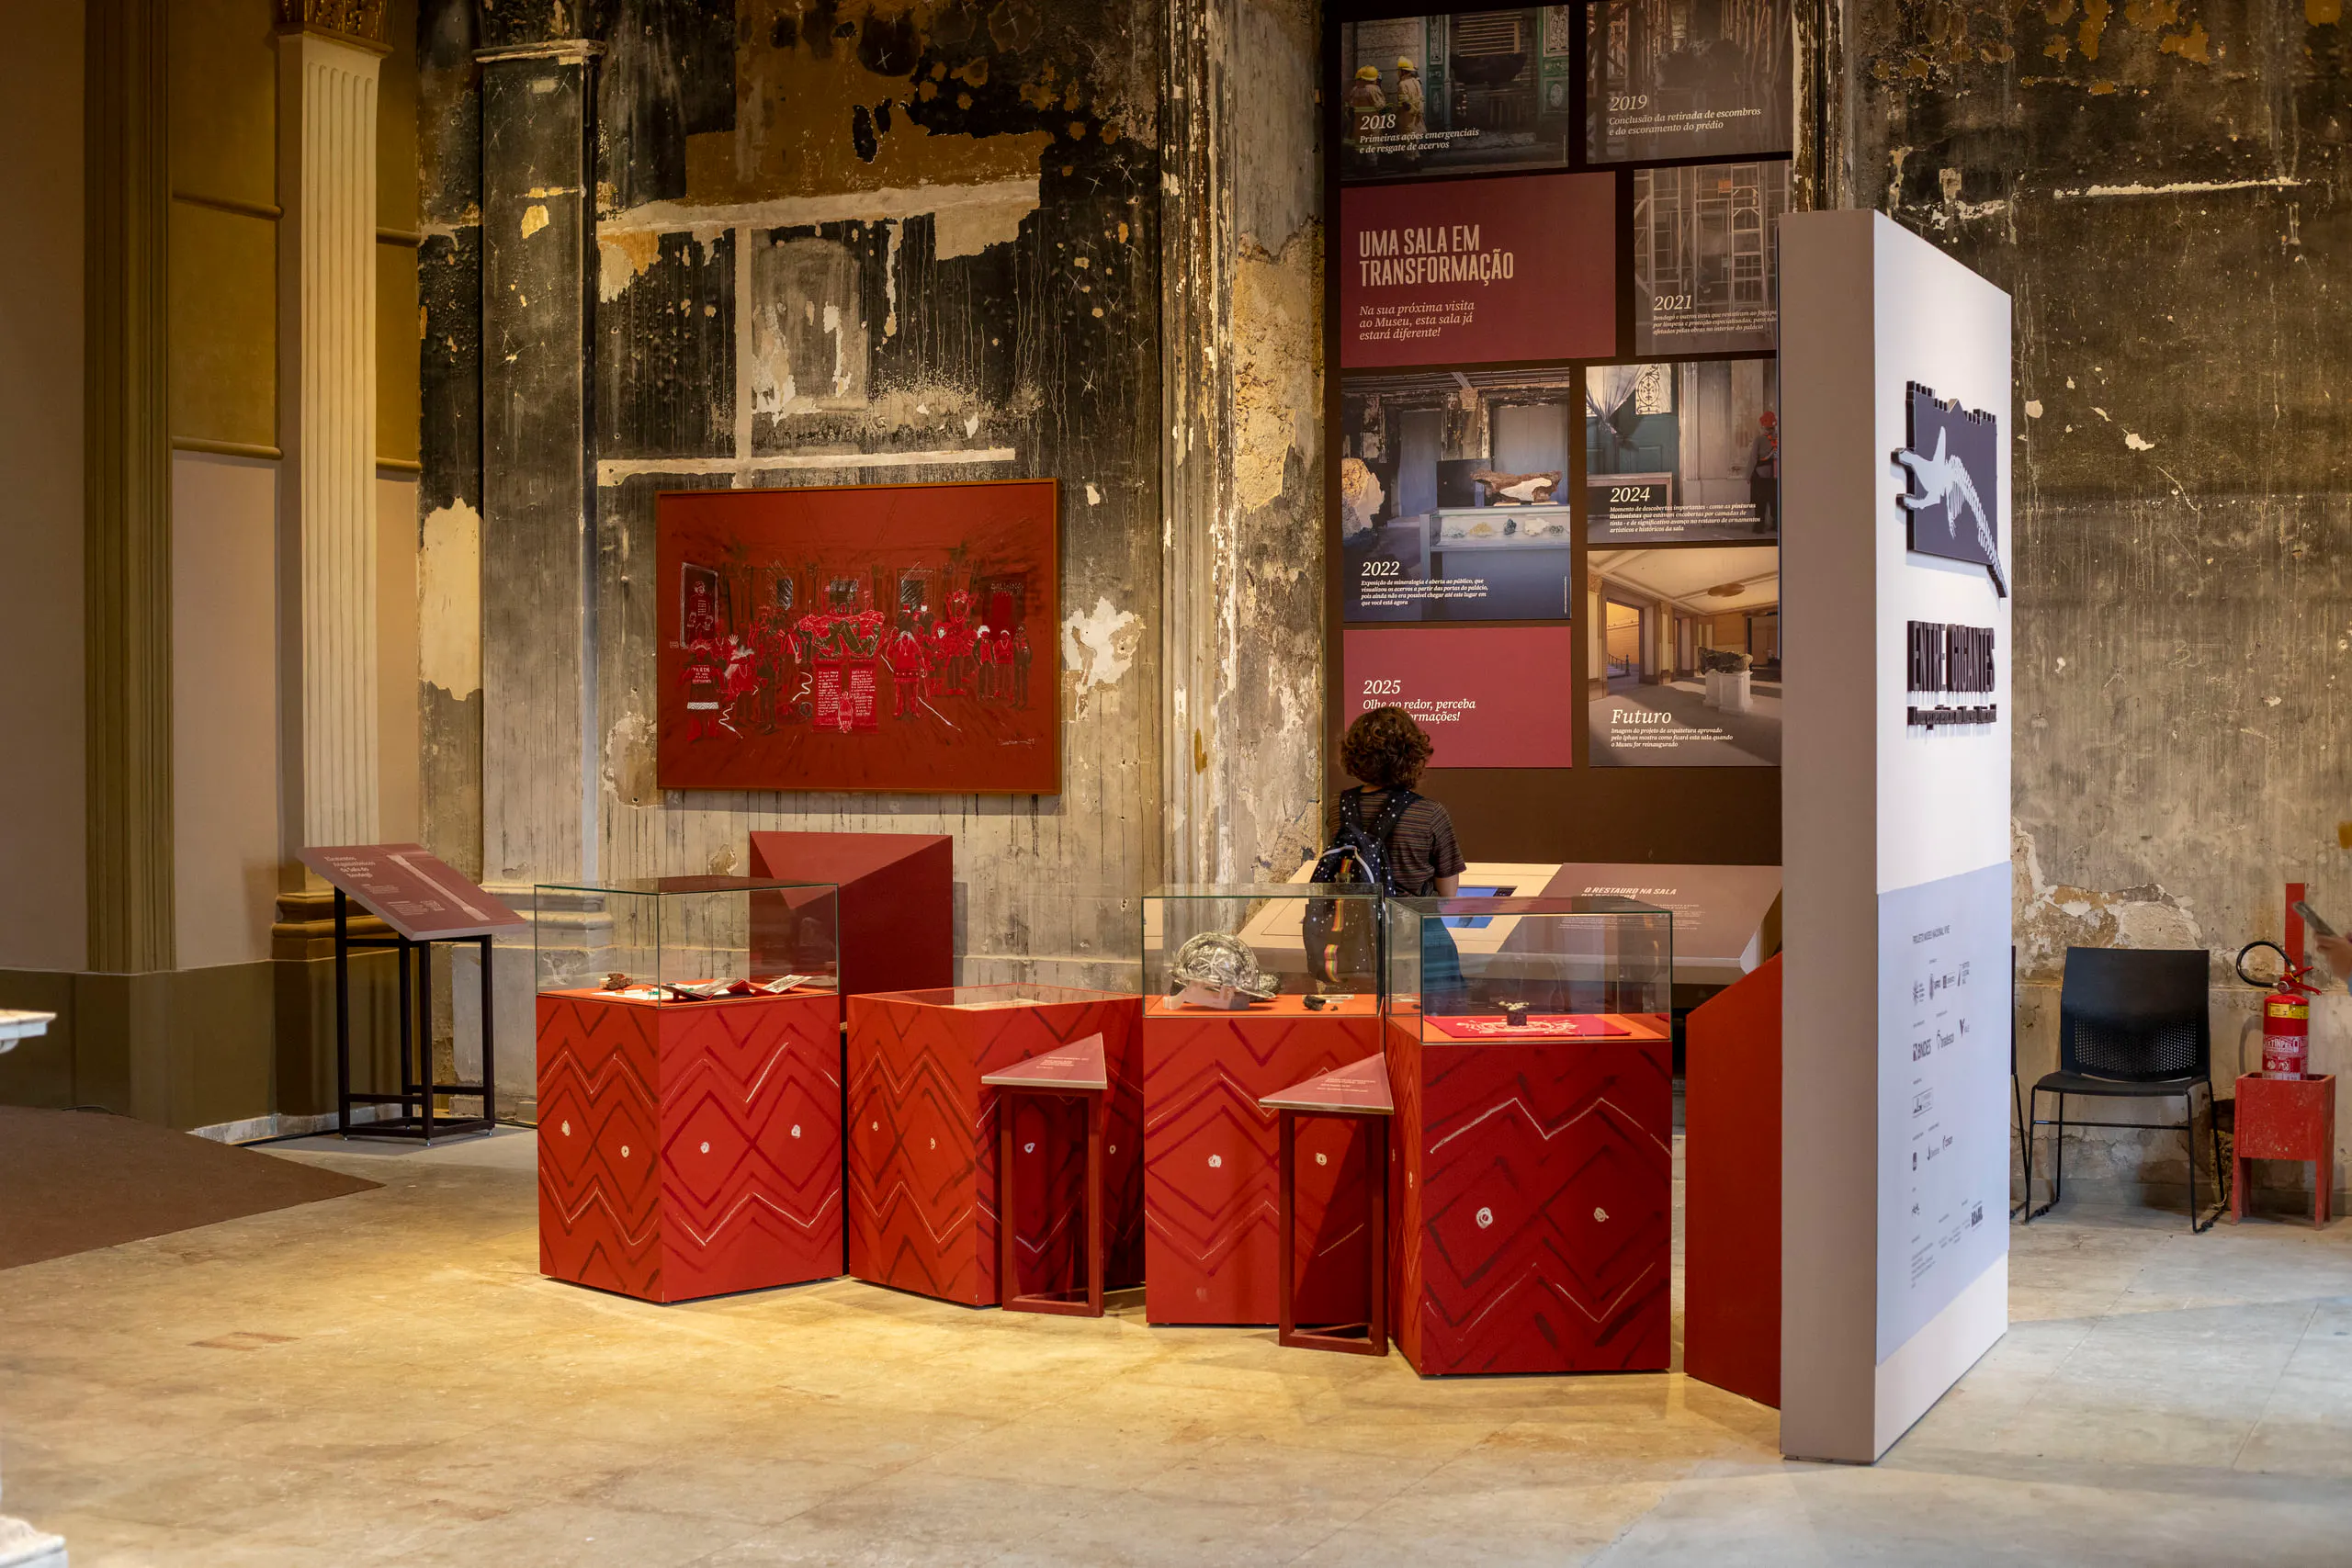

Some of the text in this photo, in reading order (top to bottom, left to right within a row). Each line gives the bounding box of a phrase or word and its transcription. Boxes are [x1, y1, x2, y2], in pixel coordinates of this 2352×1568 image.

[1610, 95, 1647, 111] 2019
[1360, 114, 1396, 130] 2018
[1609, 115, 1652, 125] Conclusão
[1667, 111, 1702, 121] retirada
[1717, 107, 1761, 118] escombros
[1615, 127, 1626, 135] do
[1628, 125, 1681, 134] escoramento
[1696, 120, 1723, 132] prédio
[1360, 128, 1479, 143] Primeiras ações emergenciais
[1377, 144, 1405, 153] resgate
[1360, 224, 1480, 257] UMA SALA EM
[1360, 248, 1514, 287] TRANSFORMAÇÃO
[1360, 301, 1475, 316] Na sua próxima visita
[1653, 295, 1692, 310] 2021
[1375, 317, 1412, 328] Museu,
[1416, 315, 1435, 325] esta
[1439, 314, 1460, 324] sala
[1462, 312, 1472, 325] já
[1360, 327, 1441, 341] estará diferente!
[1610, 487, 1650, 502] 2024
[1638, 519, 1669, 527] significativo
[1361, 561, 1400, 576] 2022
[1908, 621, 1995, 691] ENTRE GIGANTES
[1363, 680, 1401, 694] 2025
[1404, 699, 1433, 710] redor,
[1436, 698, 1476, 711] perceba
[1611, 709, 1672, 724] Futuro
